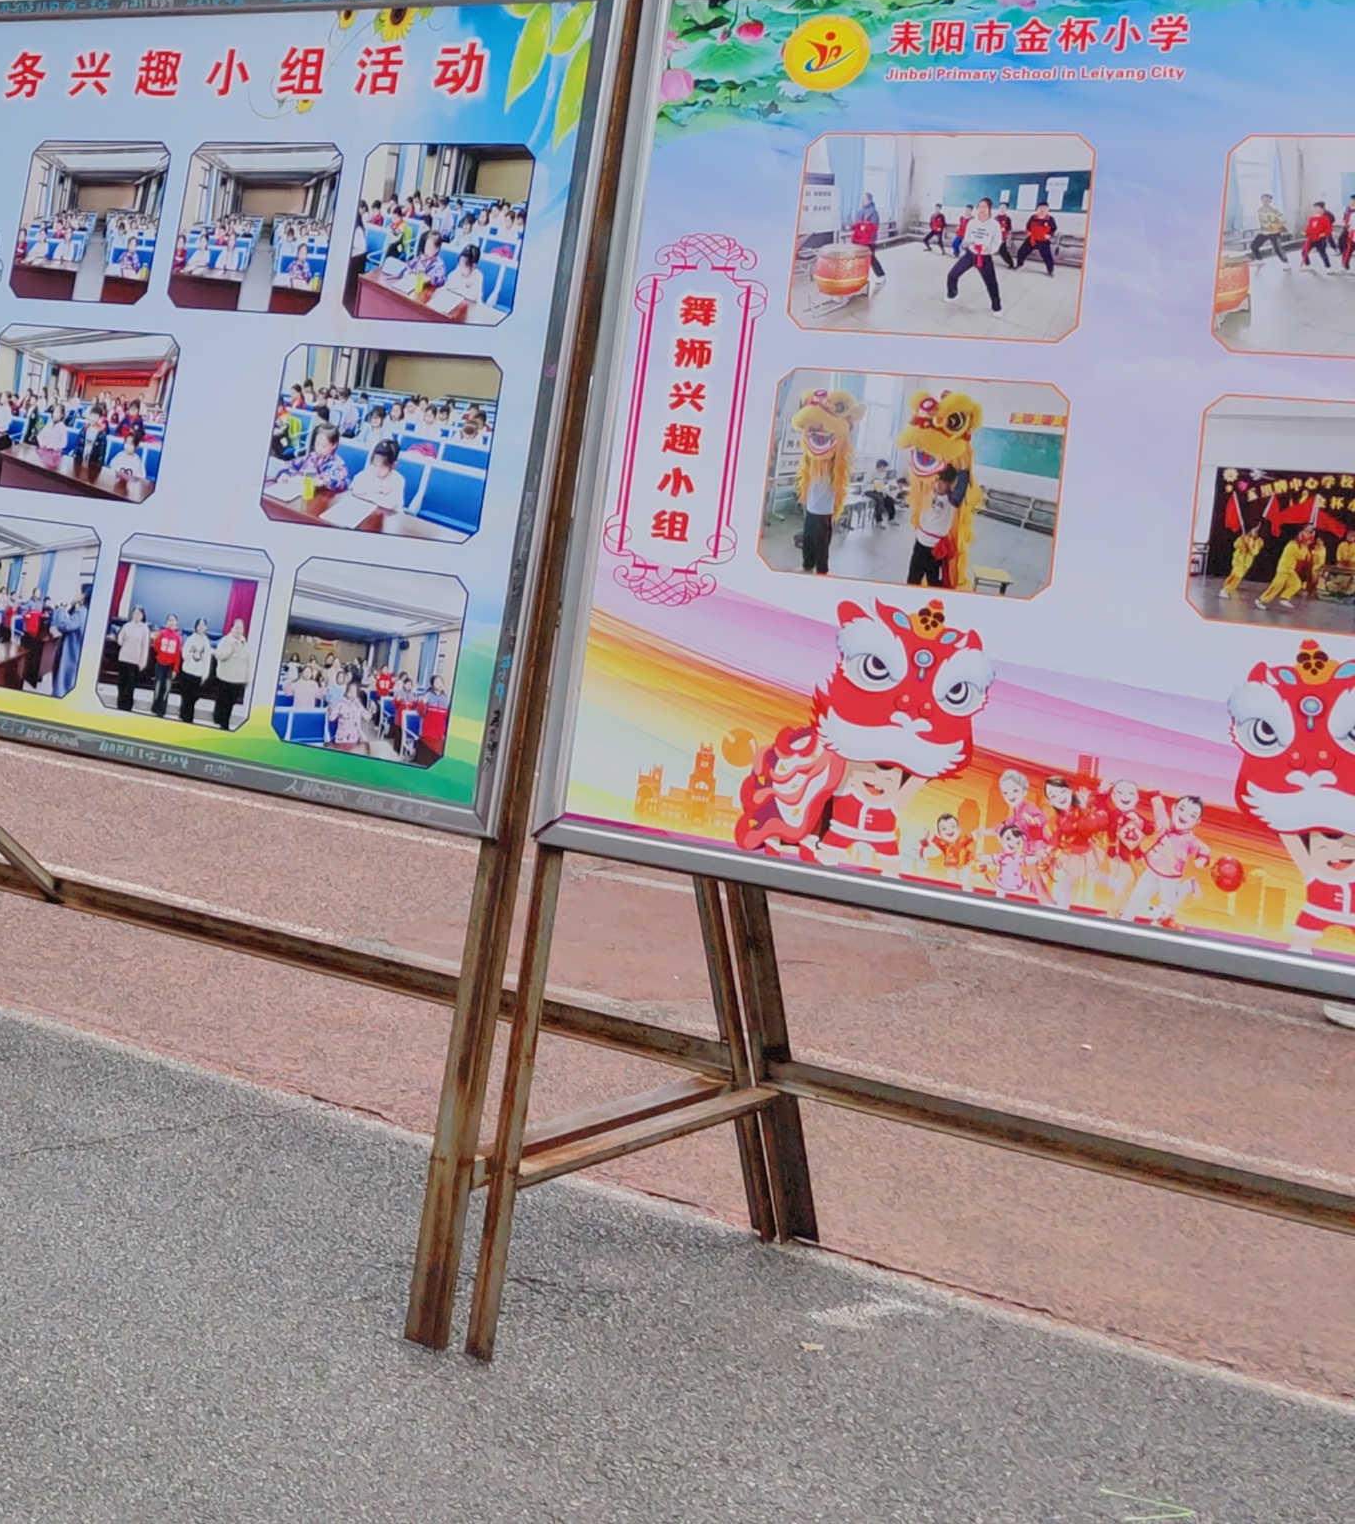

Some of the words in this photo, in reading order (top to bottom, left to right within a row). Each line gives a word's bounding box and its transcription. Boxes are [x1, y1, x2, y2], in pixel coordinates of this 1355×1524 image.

[888, 15, 1189, 54] 耒阳市金杯小学
[886, 67, 932, 81] Jinbei
[937, 67, 997, 82] Primary
[1001, 66, 1058, 80] School
[1062, 66, 1076, 80] in
[1081, 66, 1146, 82] Leiyang
[1151, 66, 1185, 82] City
[650, 295, 717, 543] 舞狮兴趣小组
